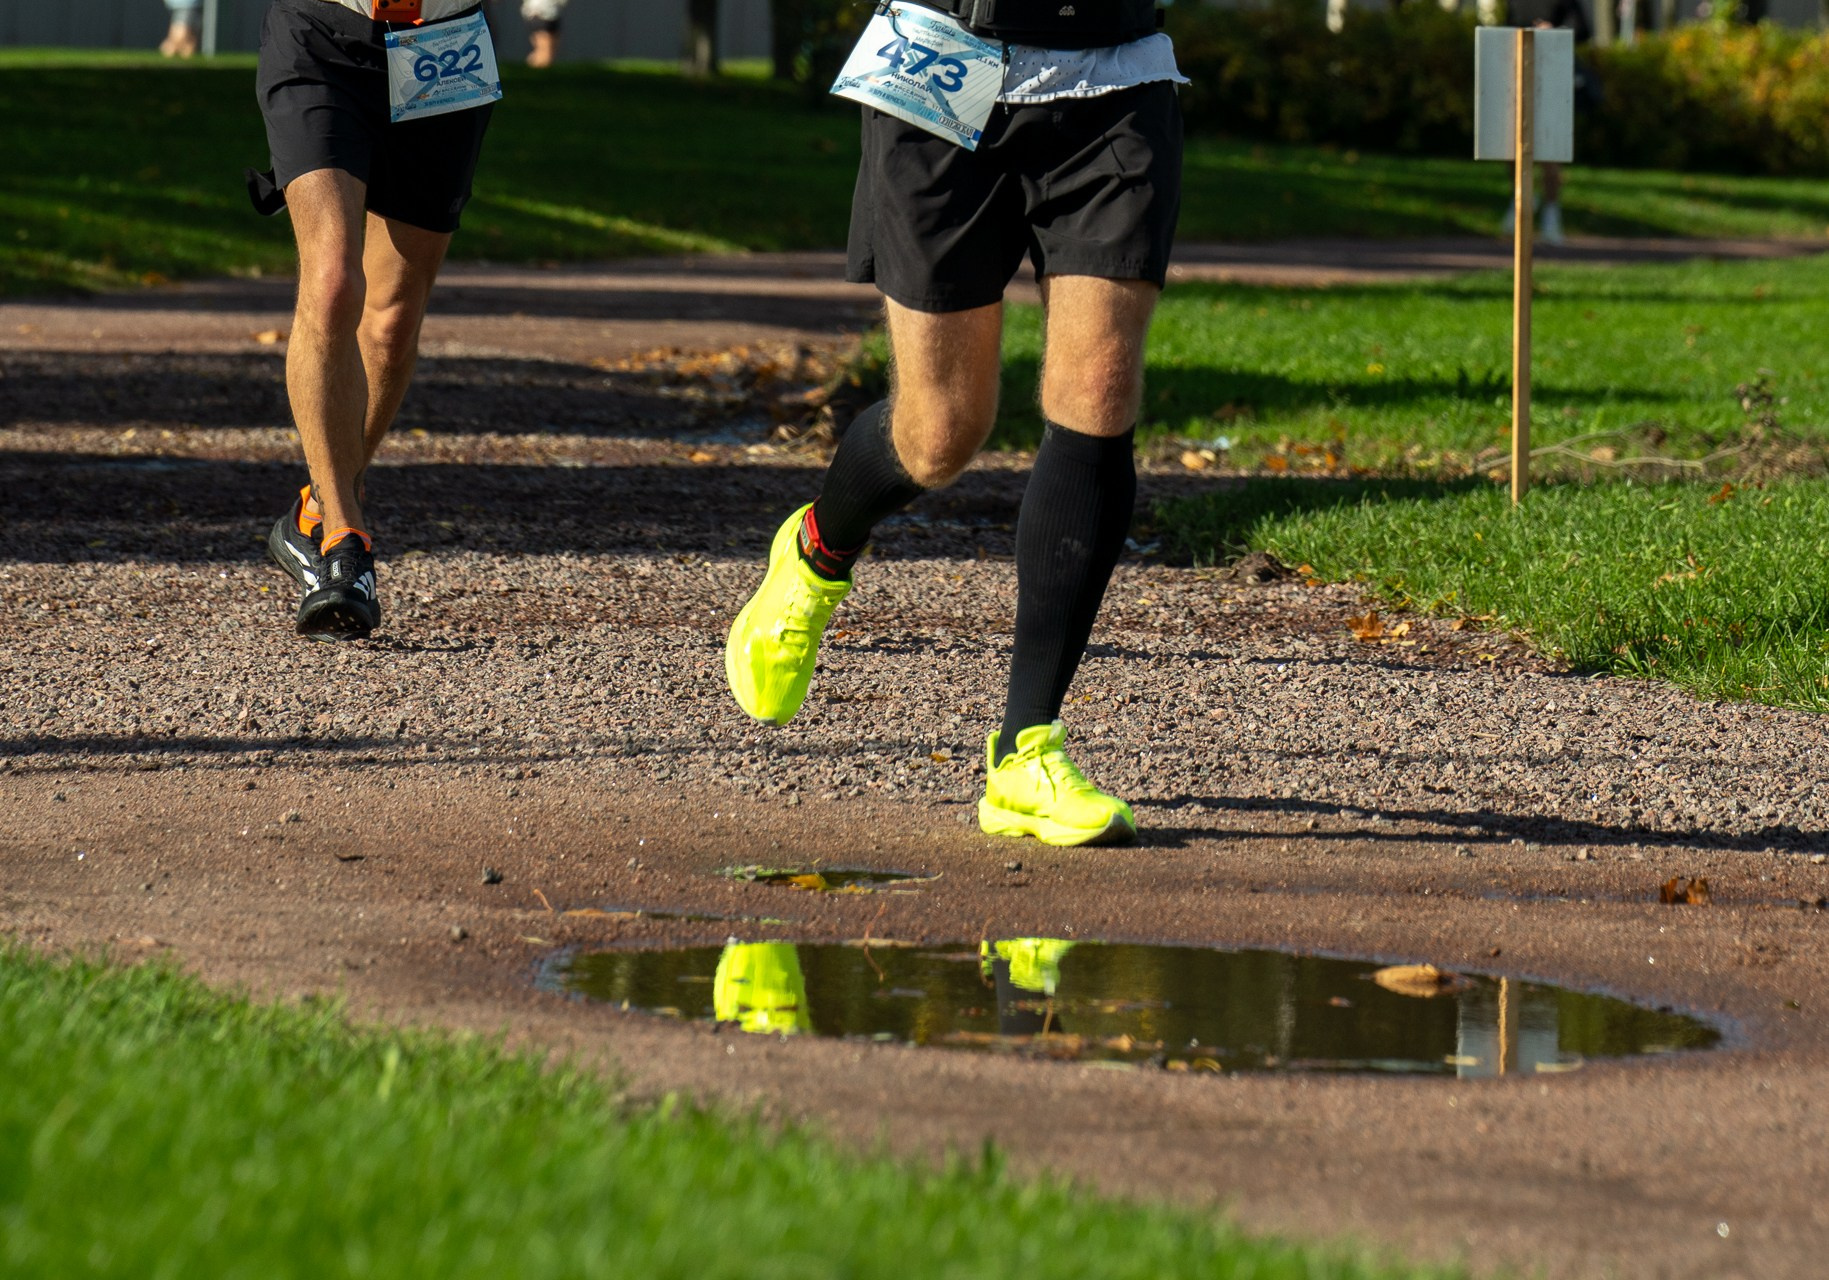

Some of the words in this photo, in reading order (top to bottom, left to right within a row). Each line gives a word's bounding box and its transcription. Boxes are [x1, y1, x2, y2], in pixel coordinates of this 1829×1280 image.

[414, 44, 483, 82] 622
[876, 37, 968, 93] 473
[891, 72, 933, 93] НИКОЛАЙ
